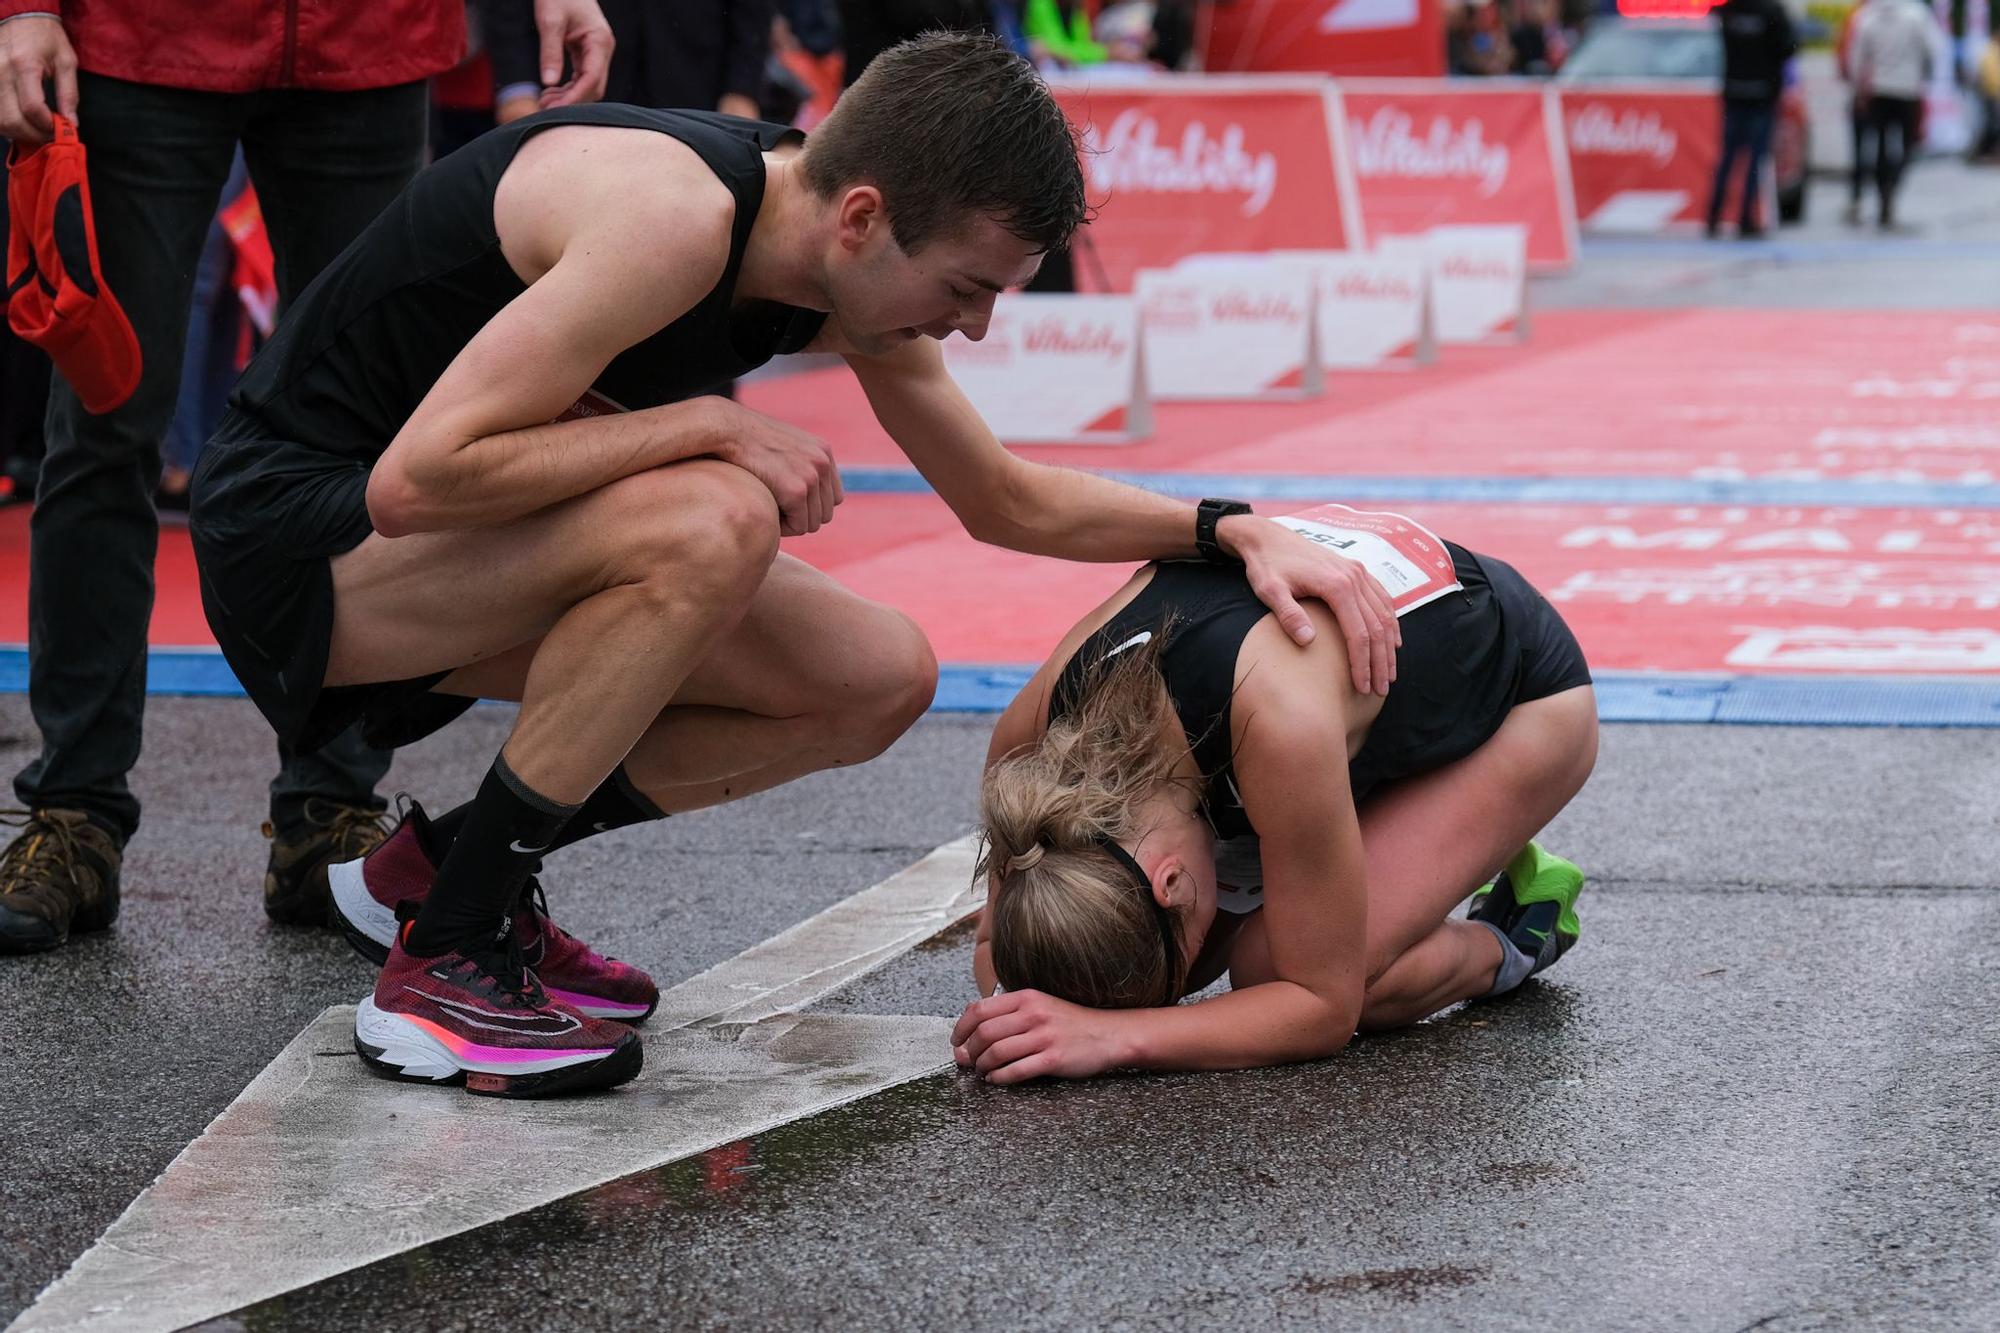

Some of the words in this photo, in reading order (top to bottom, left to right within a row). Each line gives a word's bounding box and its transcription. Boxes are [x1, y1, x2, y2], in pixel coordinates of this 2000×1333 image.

[1083, 107, 1277, 218] Vitality
[1352, 103, 1508, 198] Vitality
[1571, 102, 1677, 170] Vitality
[1023, 314, 1126, 359] Vitality
[1211, 284, 1302, 326] Vitality
